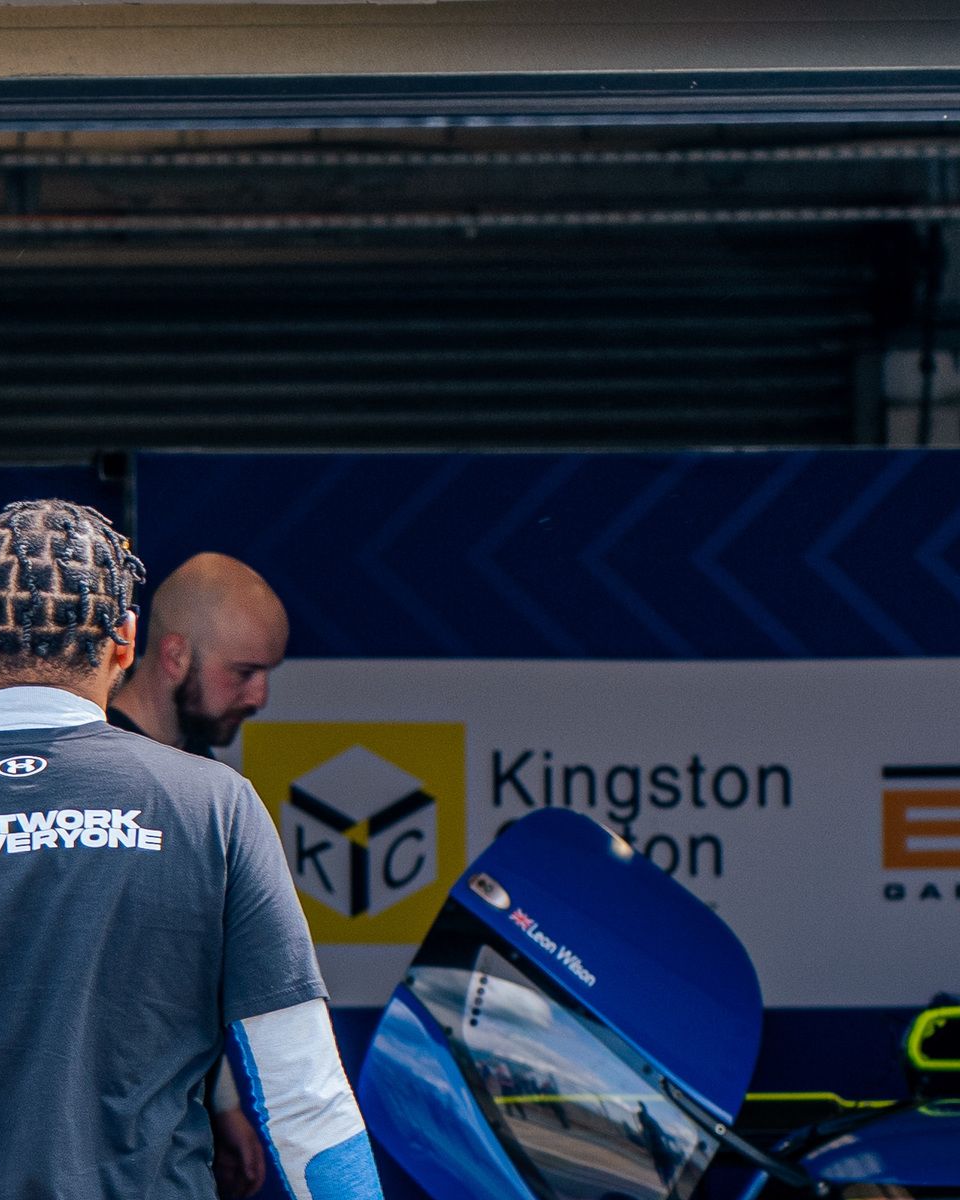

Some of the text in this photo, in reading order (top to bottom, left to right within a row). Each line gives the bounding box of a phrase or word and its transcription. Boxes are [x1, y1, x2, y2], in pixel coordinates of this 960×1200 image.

[492, 750, 792, 824] Kingston
[884, 883, 960, 900] GA
[526, 922, 597, 988] Leon Wilson
